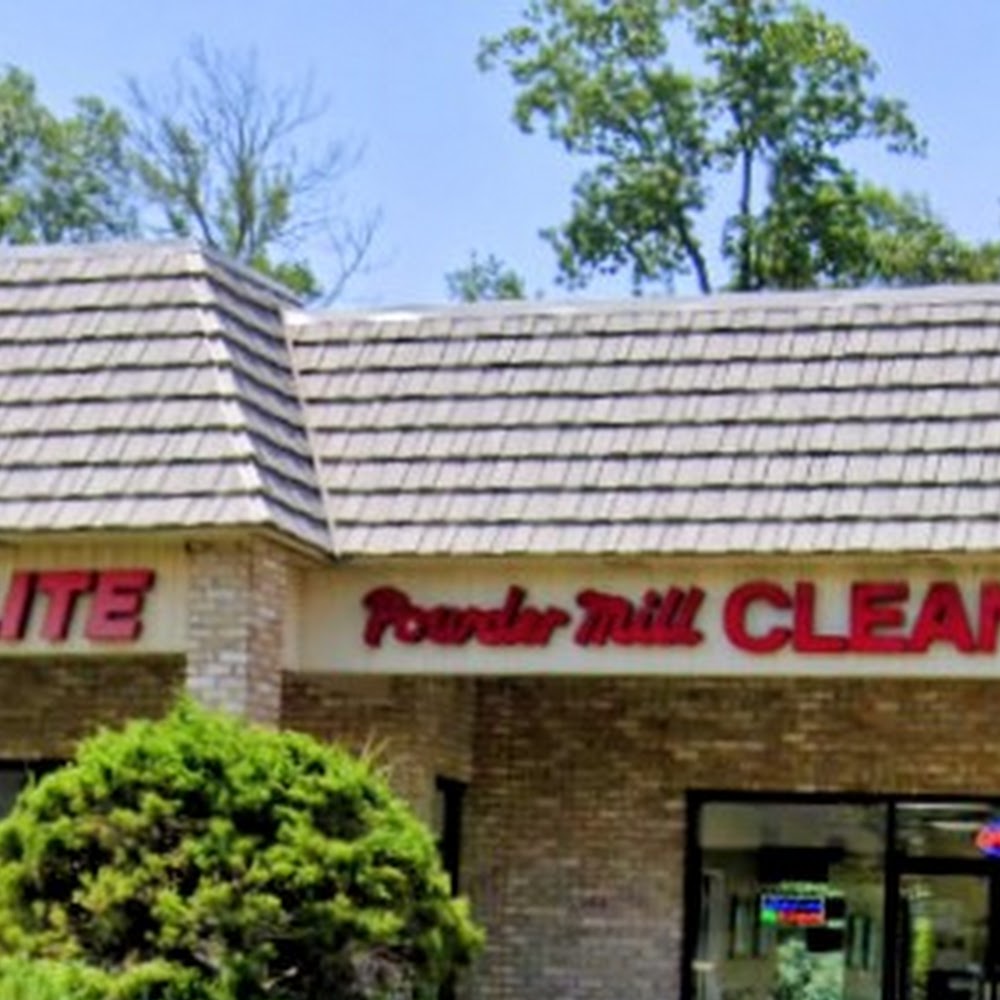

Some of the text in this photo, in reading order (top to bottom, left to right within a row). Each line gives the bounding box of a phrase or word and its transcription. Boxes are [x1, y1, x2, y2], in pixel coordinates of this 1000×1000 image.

[0, 570, 155, 641] ITE
[363, 585, 571, 647] Powder
[575, 585, 705, 647] Mill
